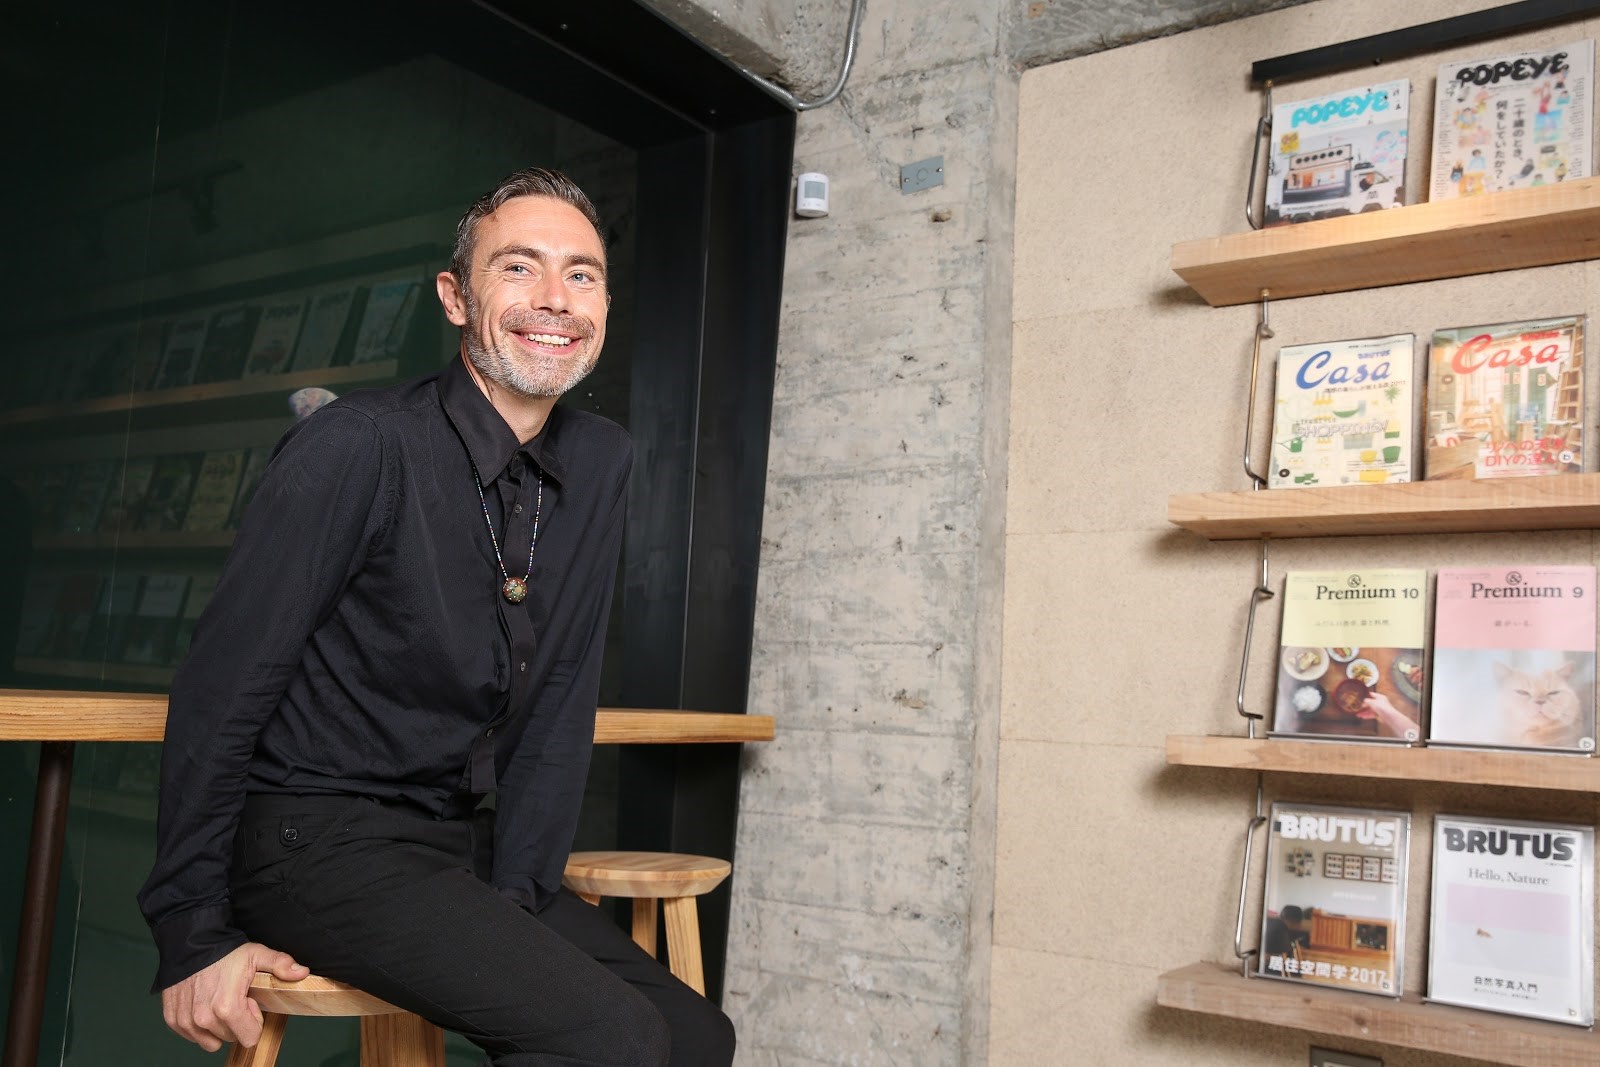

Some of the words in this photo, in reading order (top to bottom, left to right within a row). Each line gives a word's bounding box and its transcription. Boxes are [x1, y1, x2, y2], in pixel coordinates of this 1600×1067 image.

[1456, 52, 1569, 87] POPEYE
[1291, 91, 1389, 128] POPEYE
[1296, 350, 1391, 390] Casa
[1451, 334, 1559, 374] Casa
[1315, 584, 1396, 600] Premium
[1402, 588, 1419, 599] 10
[1470, 582, 1562, 598] Premium
[1572, 586, 1584, 598] 9
[1279, 813, 1396, 847] BRUTUS
[1443, 827, 1576, 862] BRUTUS
[1468, 867, 1505, 883] Hello,
[1507, 870, 1550, 886] Nature
[1349, 966, 1387, 986] 2017
[1473, 975, 1538, 993] 自然写真入門
